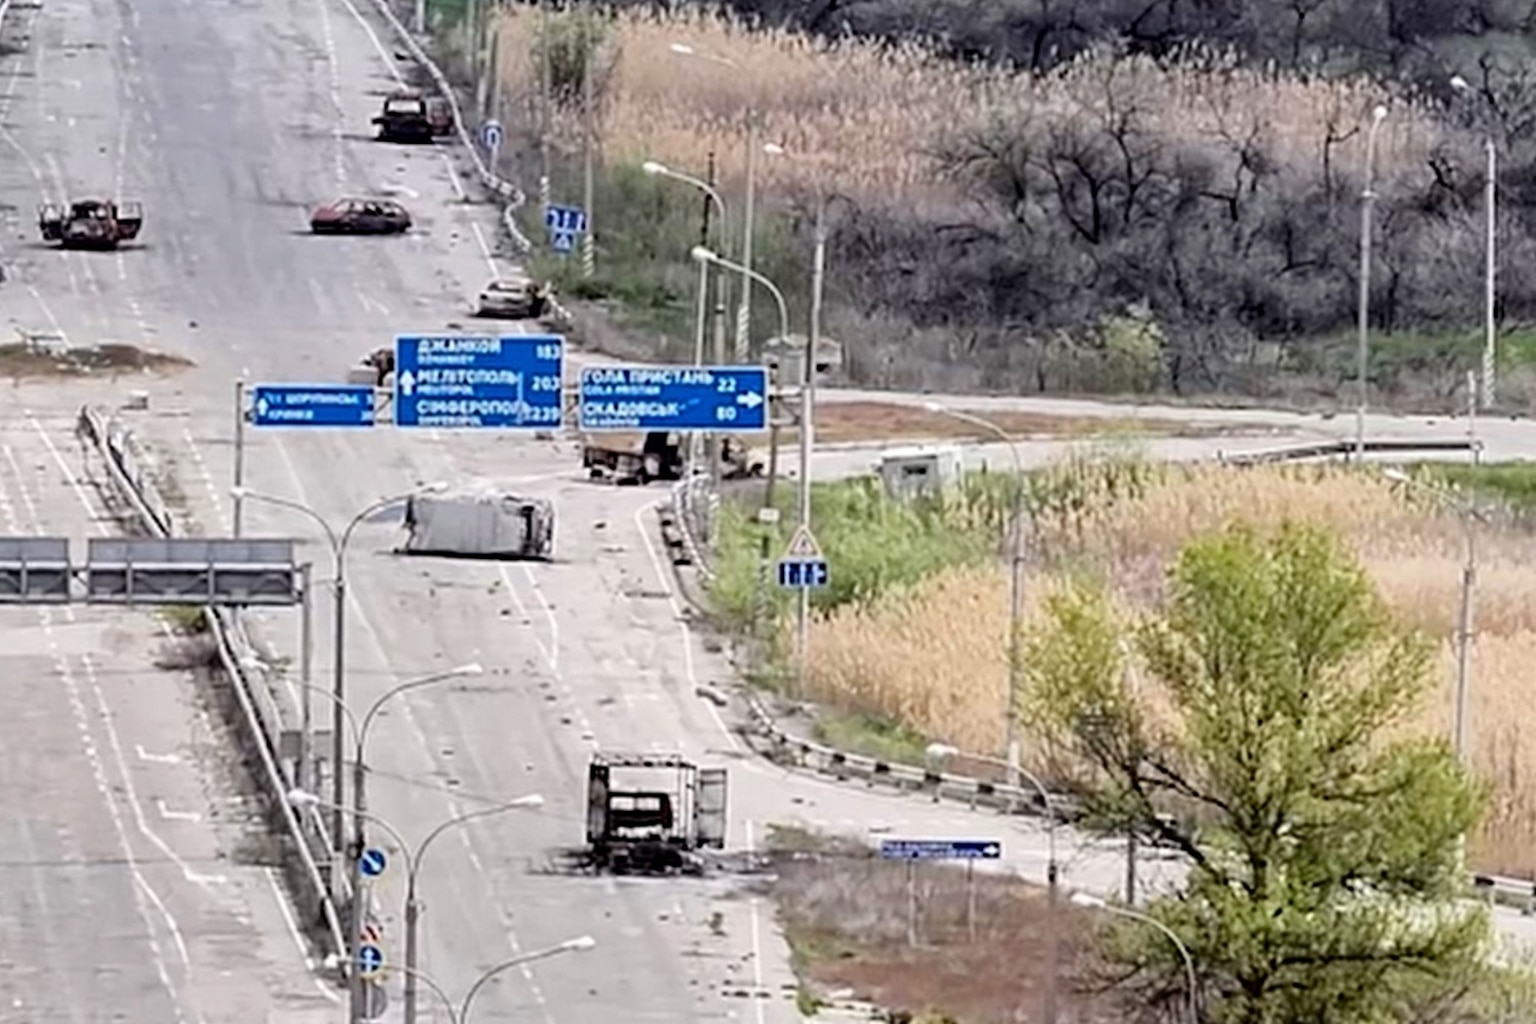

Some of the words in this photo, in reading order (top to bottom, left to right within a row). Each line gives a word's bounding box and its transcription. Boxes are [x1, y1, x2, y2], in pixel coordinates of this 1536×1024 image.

[417, 339, 502, 354] ДЖАНКОЙ
[536, 344, 560, 360] 183
[417, 369, 519, 384] МЕЛІТОПОЛЬ
[531, 376, 560, 391] 203
[583, 371, 625, 383] ГОЛА
[630, 371, 714, 385] ПРИСТАНЬ
[717, 377, 737, 393] 22
[583, 402, 680, 416] СКАДОВСЬК
[716, 406, 738, 421] 80
